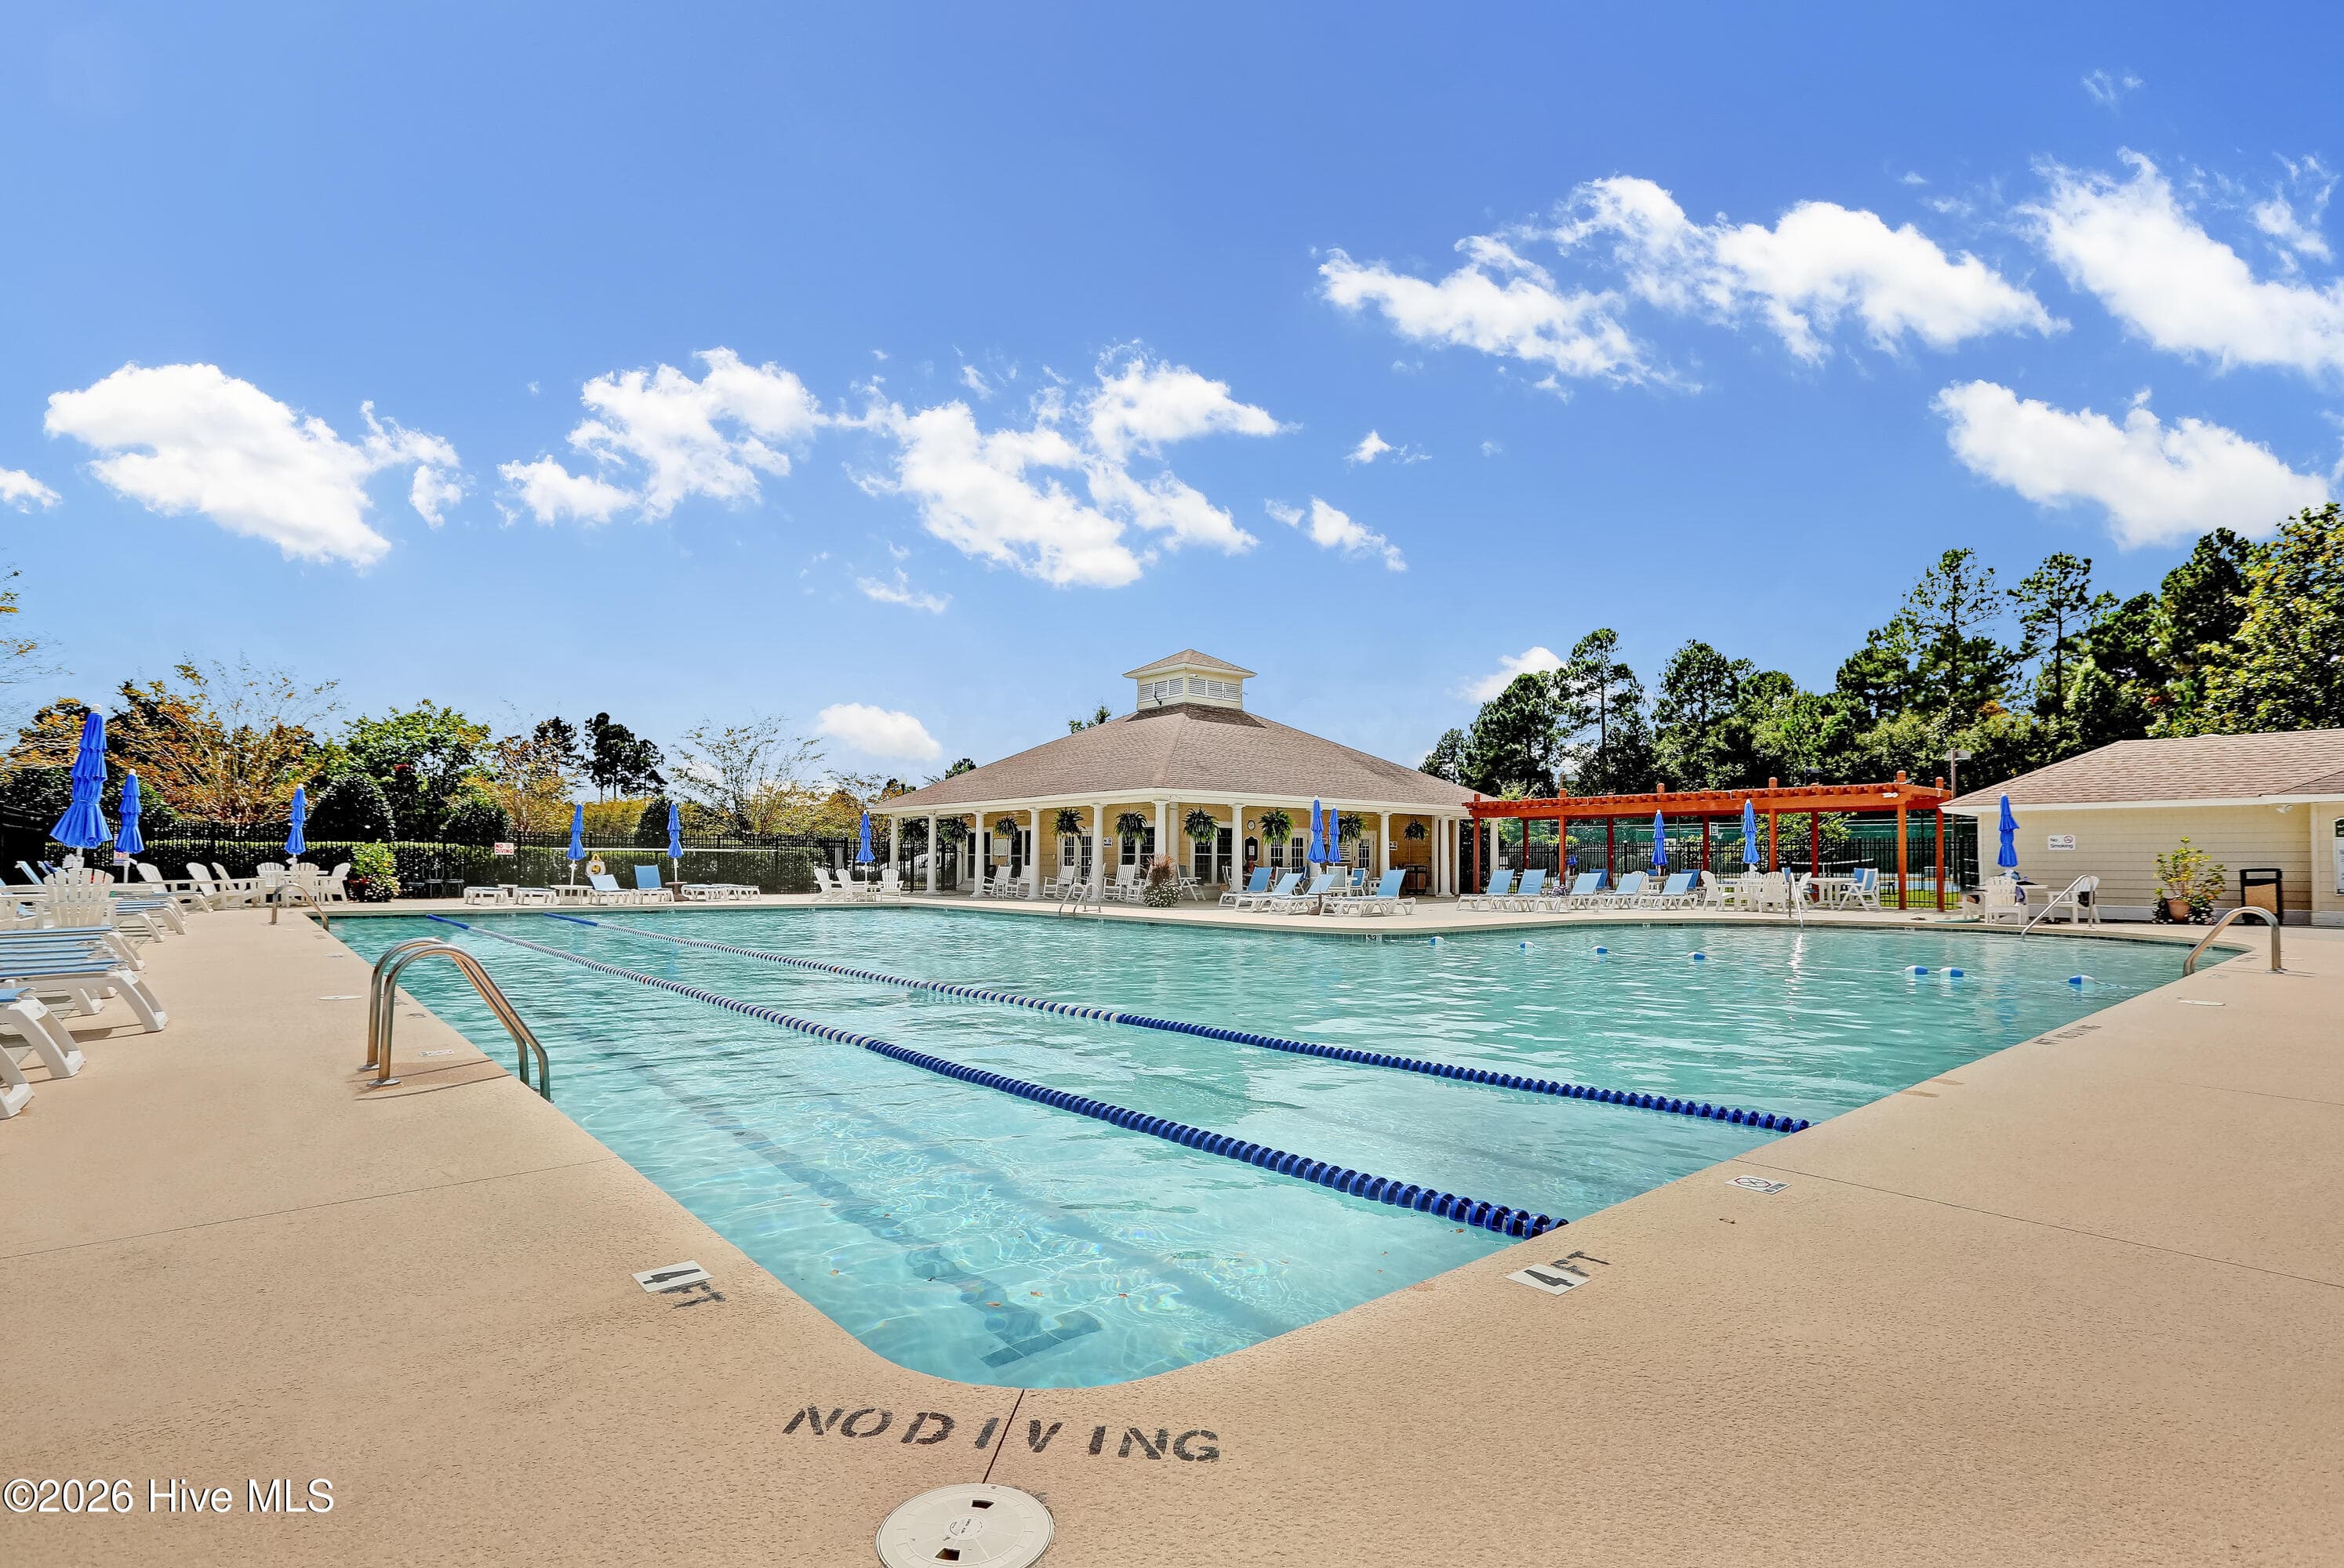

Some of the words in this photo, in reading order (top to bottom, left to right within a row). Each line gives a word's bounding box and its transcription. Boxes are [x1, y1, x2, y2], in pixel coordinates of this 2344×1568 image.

[642, 1269, 702, 1284] 4
[1524, 1269, 1575, 1287] 4
[1550, 1250, 1612, 1277] FT
[783, 1406, 892, 1439] NO
[901, 1410, 1220, 1461] DIVING
